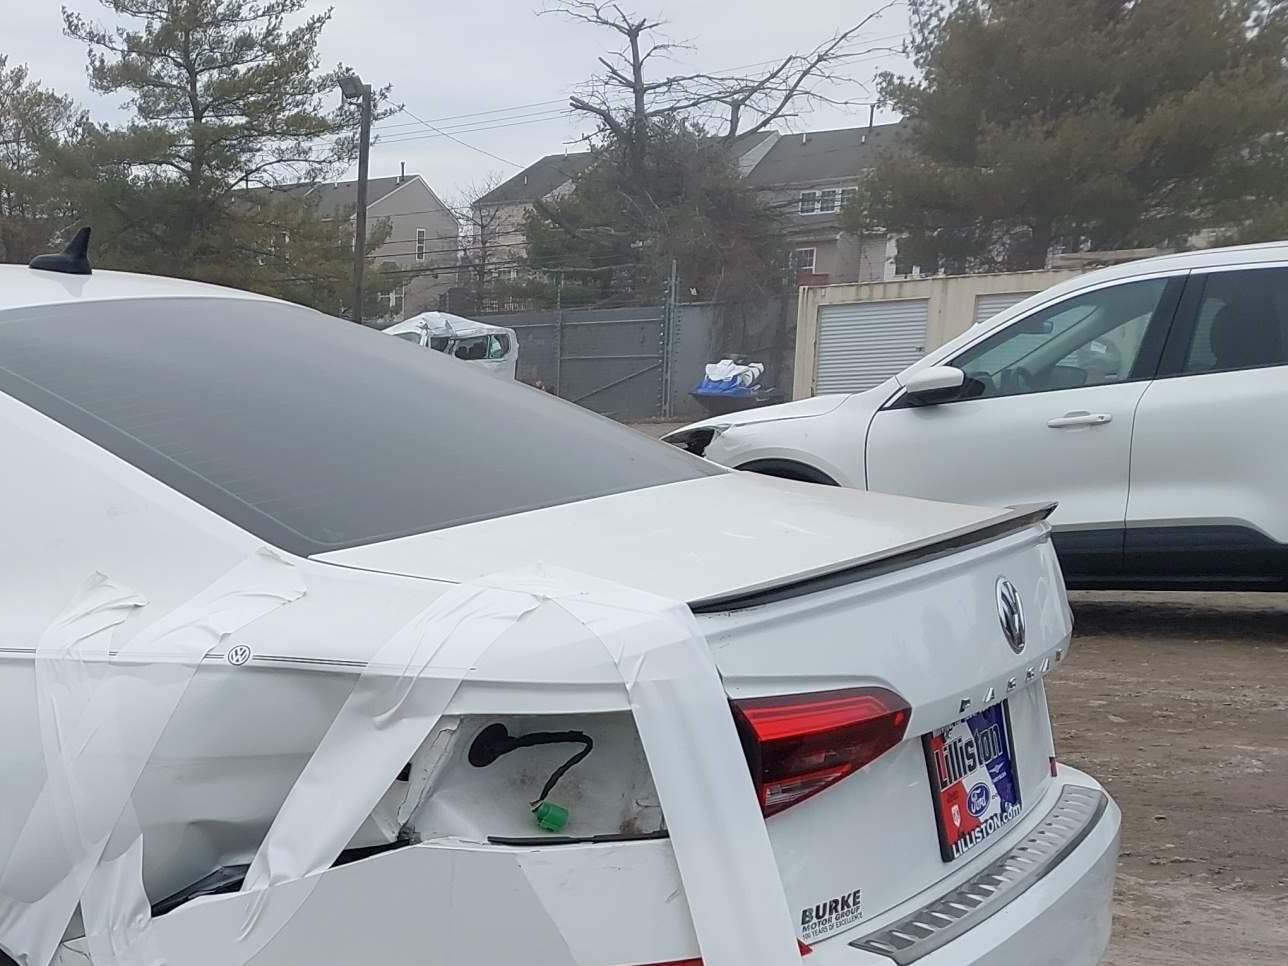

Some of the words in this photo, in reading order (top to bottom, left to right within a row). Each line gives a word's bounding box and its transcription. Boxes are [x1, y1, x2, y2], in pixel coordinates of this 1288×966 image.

[934, 723, 1003, 792] Lilliston
[952, 803, 1021, 858] LILLISTON.com
[801, 889, 861, 925] BURKE
[802, 917, 833, 932] MOTOR
[835, 905, 861, 920] GROUP
[812, 925, 828, 937] YEARS
[836, 911, 863, 928] EXCELLENCE
